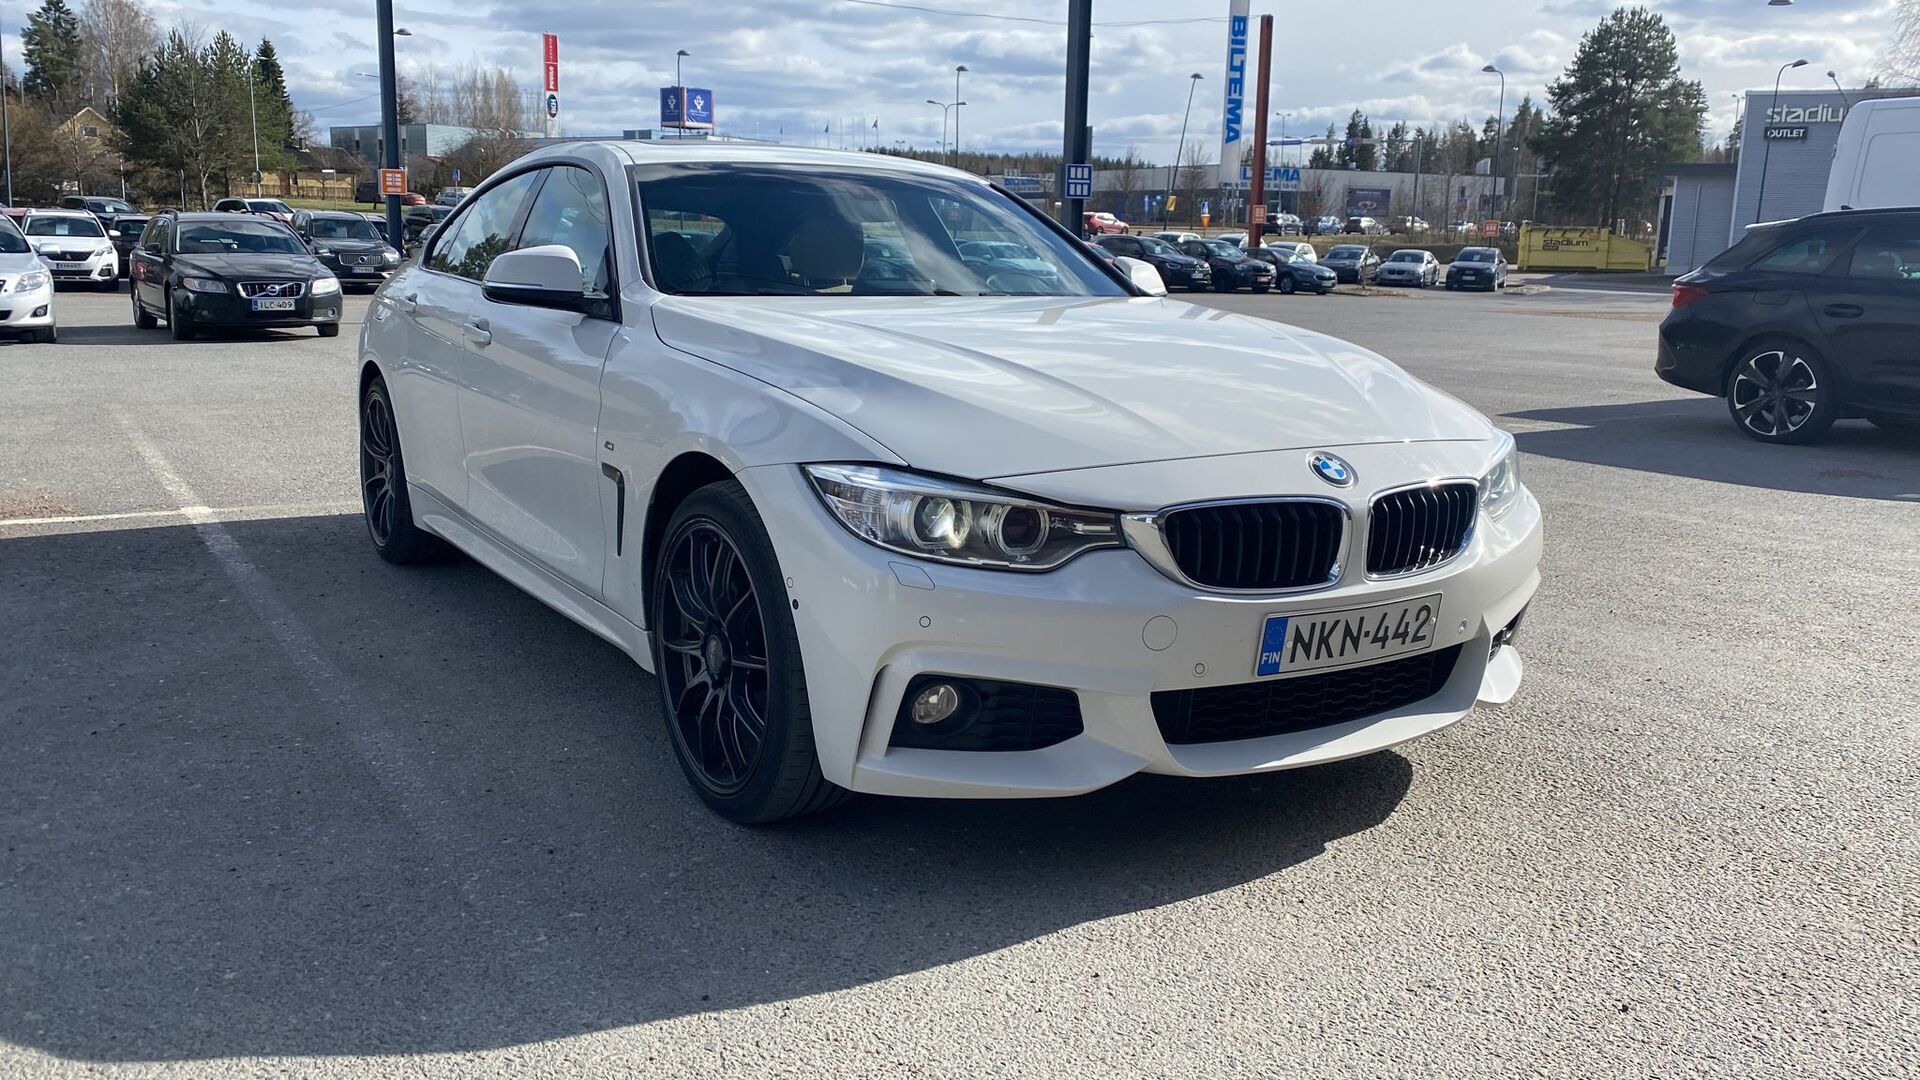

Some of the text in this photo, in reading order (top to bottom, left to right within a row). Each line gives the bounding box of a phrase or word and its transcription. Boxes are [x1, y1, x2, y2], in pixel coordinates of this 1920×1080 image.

[1225, 15, 1248, 144] BILTEMA
[1765, 104, 1846, 123] stadiu
[1767, 128, 1805, 138] OUTLET
[1543, 238, 1589, 246] stadium
[1290, 604, 1432, 663] NKN-442
[1261, 651, 1281, 665] FIN
